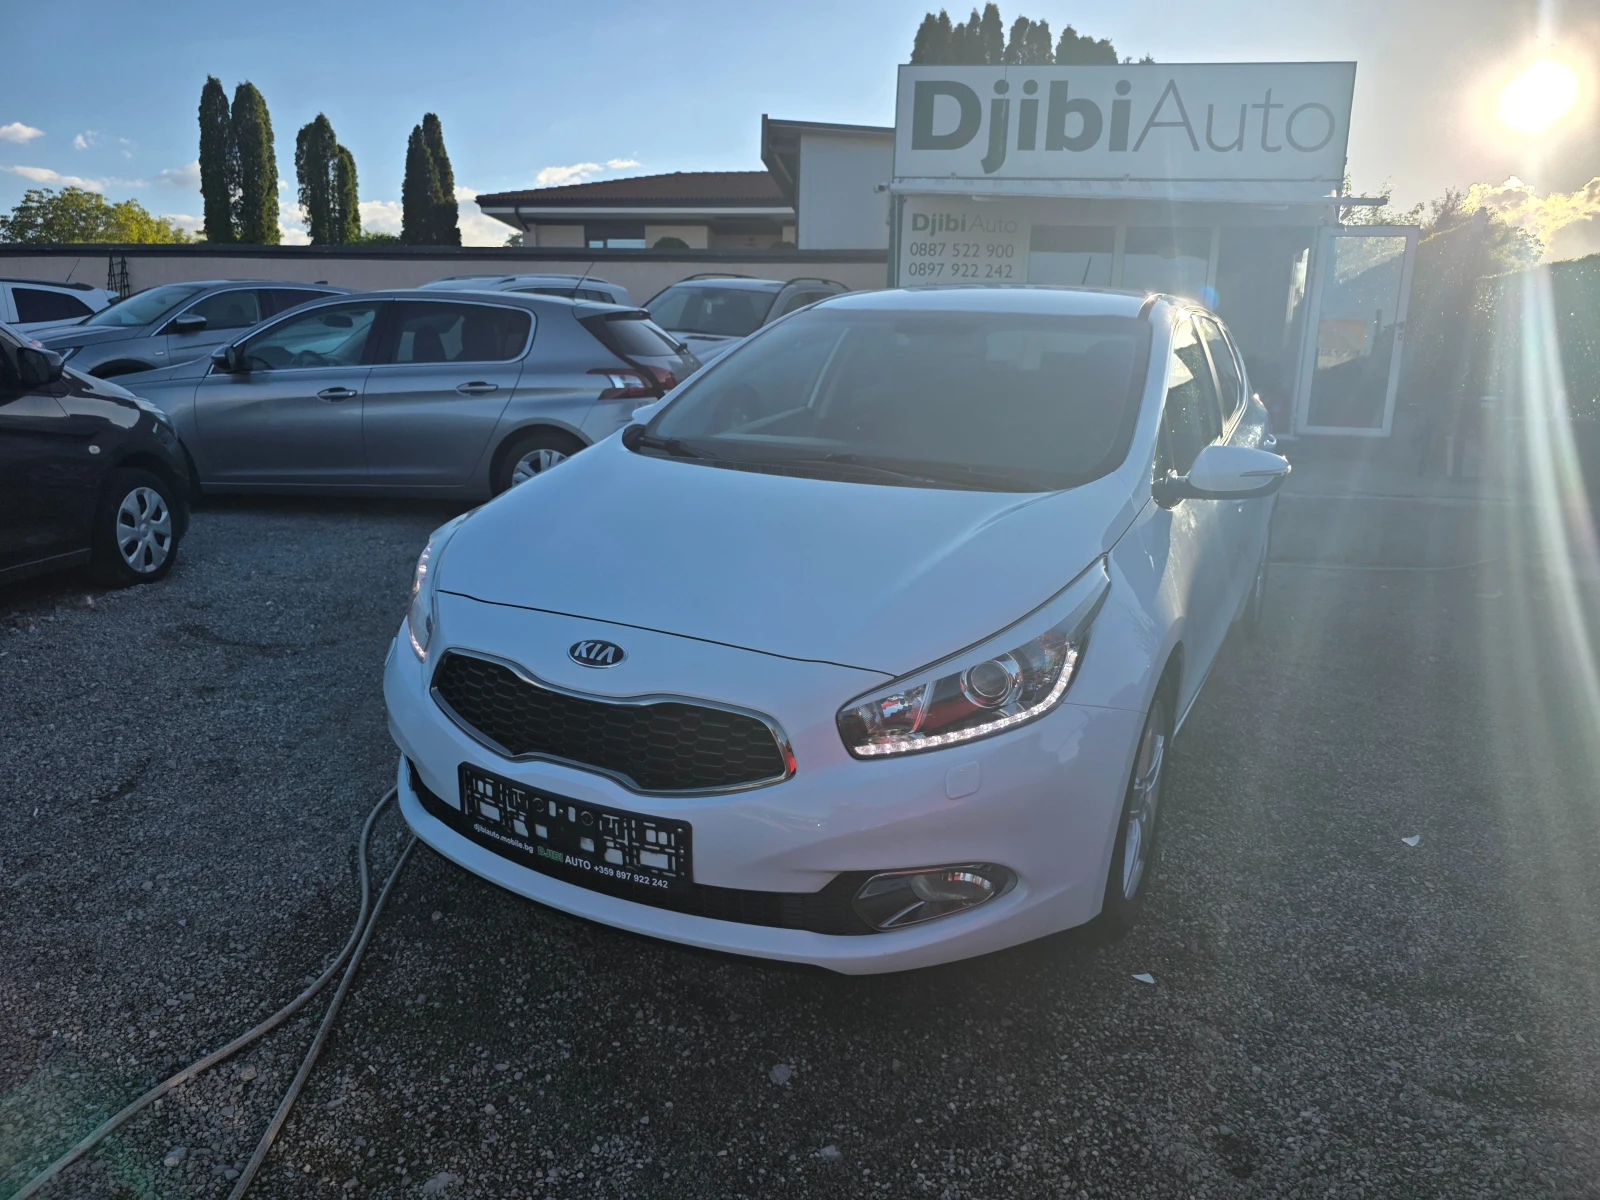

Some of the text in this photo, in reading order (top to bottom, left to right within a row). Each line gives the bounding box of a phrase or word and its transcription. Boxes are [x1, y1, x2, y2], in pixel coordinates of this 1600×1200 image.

[910, 242, 1014, 259] 0887 522 900
[908, 262, 1013, 279] 0897 922 242
[573, 641, 616, 664] KIA
[473, 823, 669, 889] djibiauto.mobile.bg DJIBI AUTO +359 897 922 242
